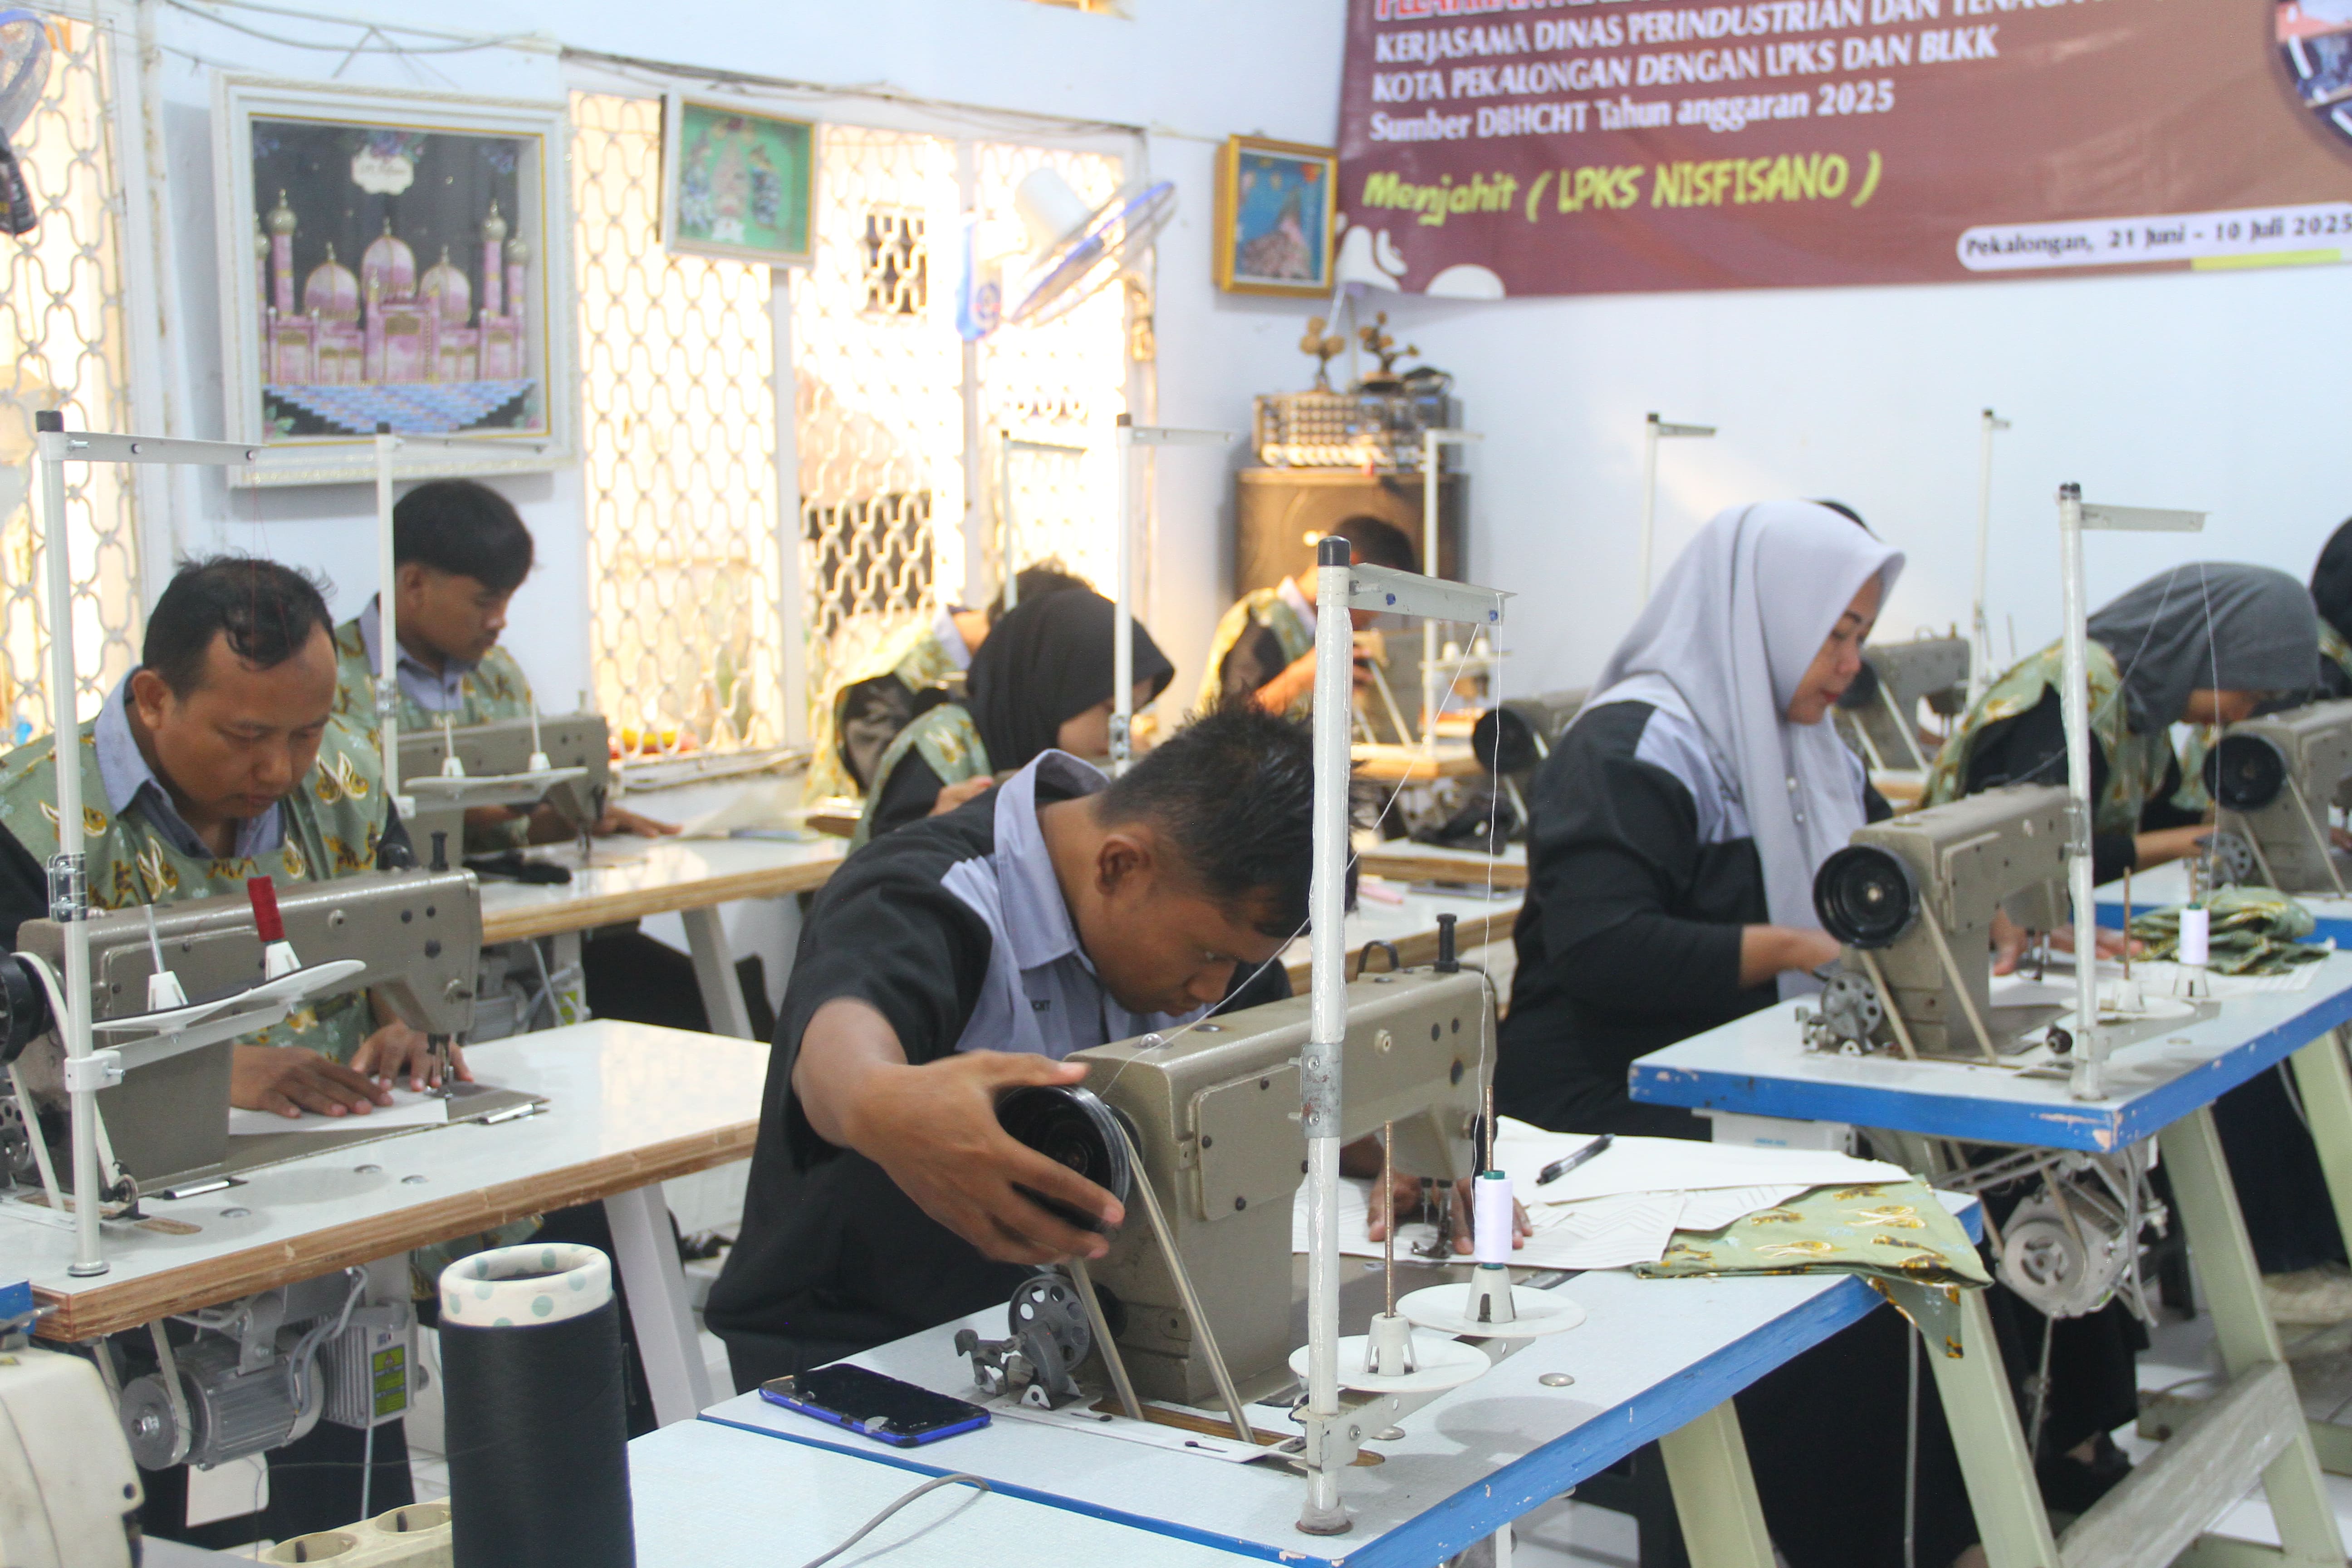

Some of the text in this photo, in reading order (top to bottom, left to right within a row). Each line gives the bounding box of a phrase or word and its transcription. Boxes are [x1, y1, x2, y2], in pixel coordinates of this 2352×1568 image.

[1372, 24, 1998, 103] KOTA PEKALONGAN DENGAN LPKS DAN BLKK
[1375, 23, 1529, 64] KERJASAMA
[1534, 15, 1624, 51] DINAS
[1627, 0, 1864, 44] PERINDUSTRIAN
[1871, 0, 1940, 24] DAN
[1369, 79, 1895, 142] Sumber DBHCHT Tahun anggaran 2025
[1362, 172, 1517, 226] Menjahit
[1558, 165, 1644, 213] LPKS
[1651, 154, 1849, 206] NISFISANO
[1967, 234, 2094, 258] Pekalongan,
[2109, 229, 2134, 248] 21
[2146, 225, 2185, 248] Juni
[2216, 222, 2241, 241] 10
[2250, 217, 2284, 241] Juli
[2294, 214, 2352, 236] 2025
